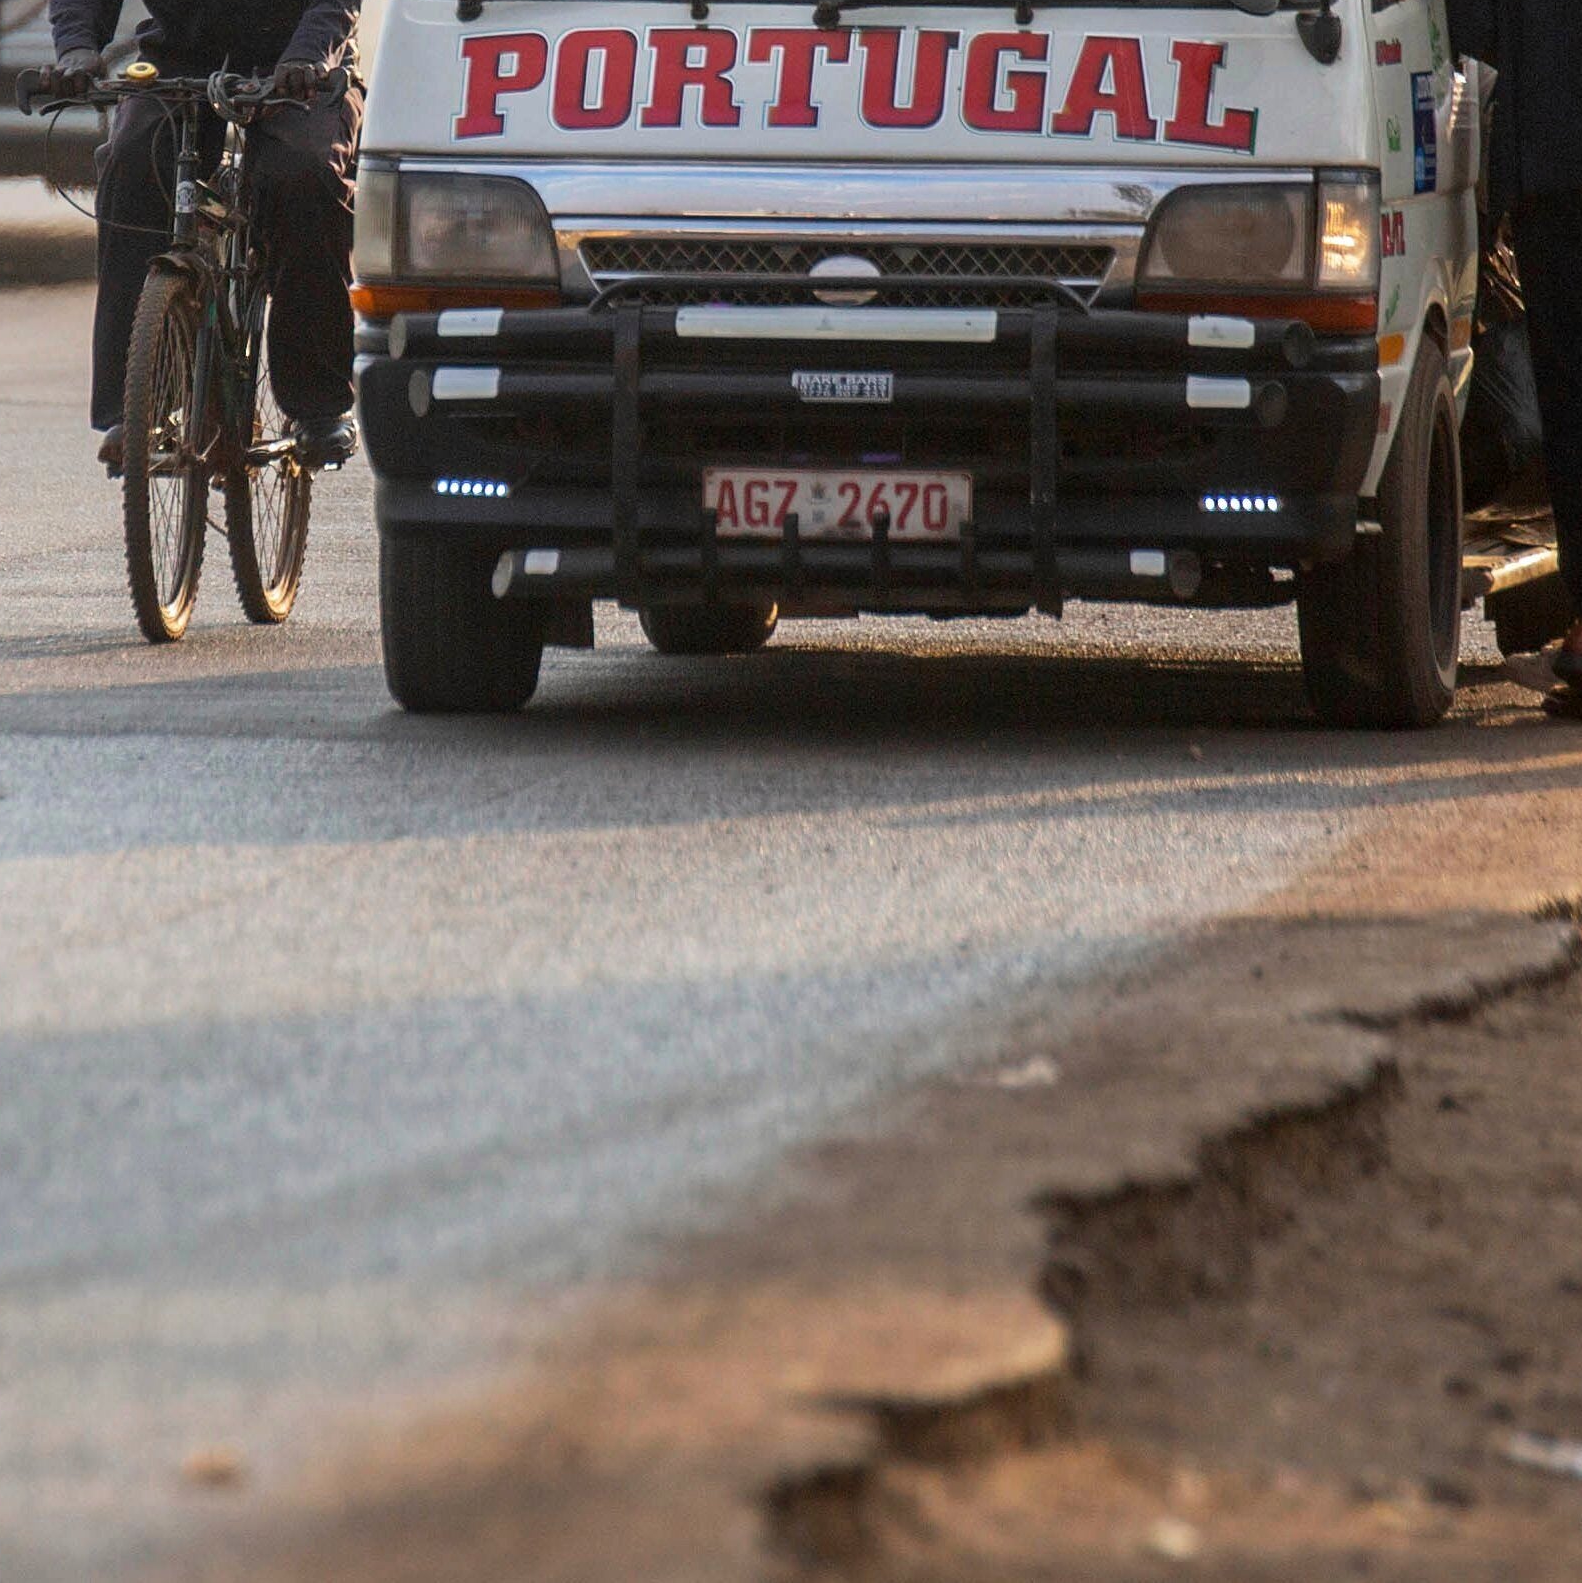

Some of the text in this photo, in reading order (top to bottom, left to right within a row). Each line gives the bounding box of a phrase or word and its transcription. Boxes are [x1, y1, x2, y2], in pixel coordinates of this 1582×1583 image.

[450, 25, 1260, 156] PORTUGAL
[716, 478, 949, 531] AGZ 2670
